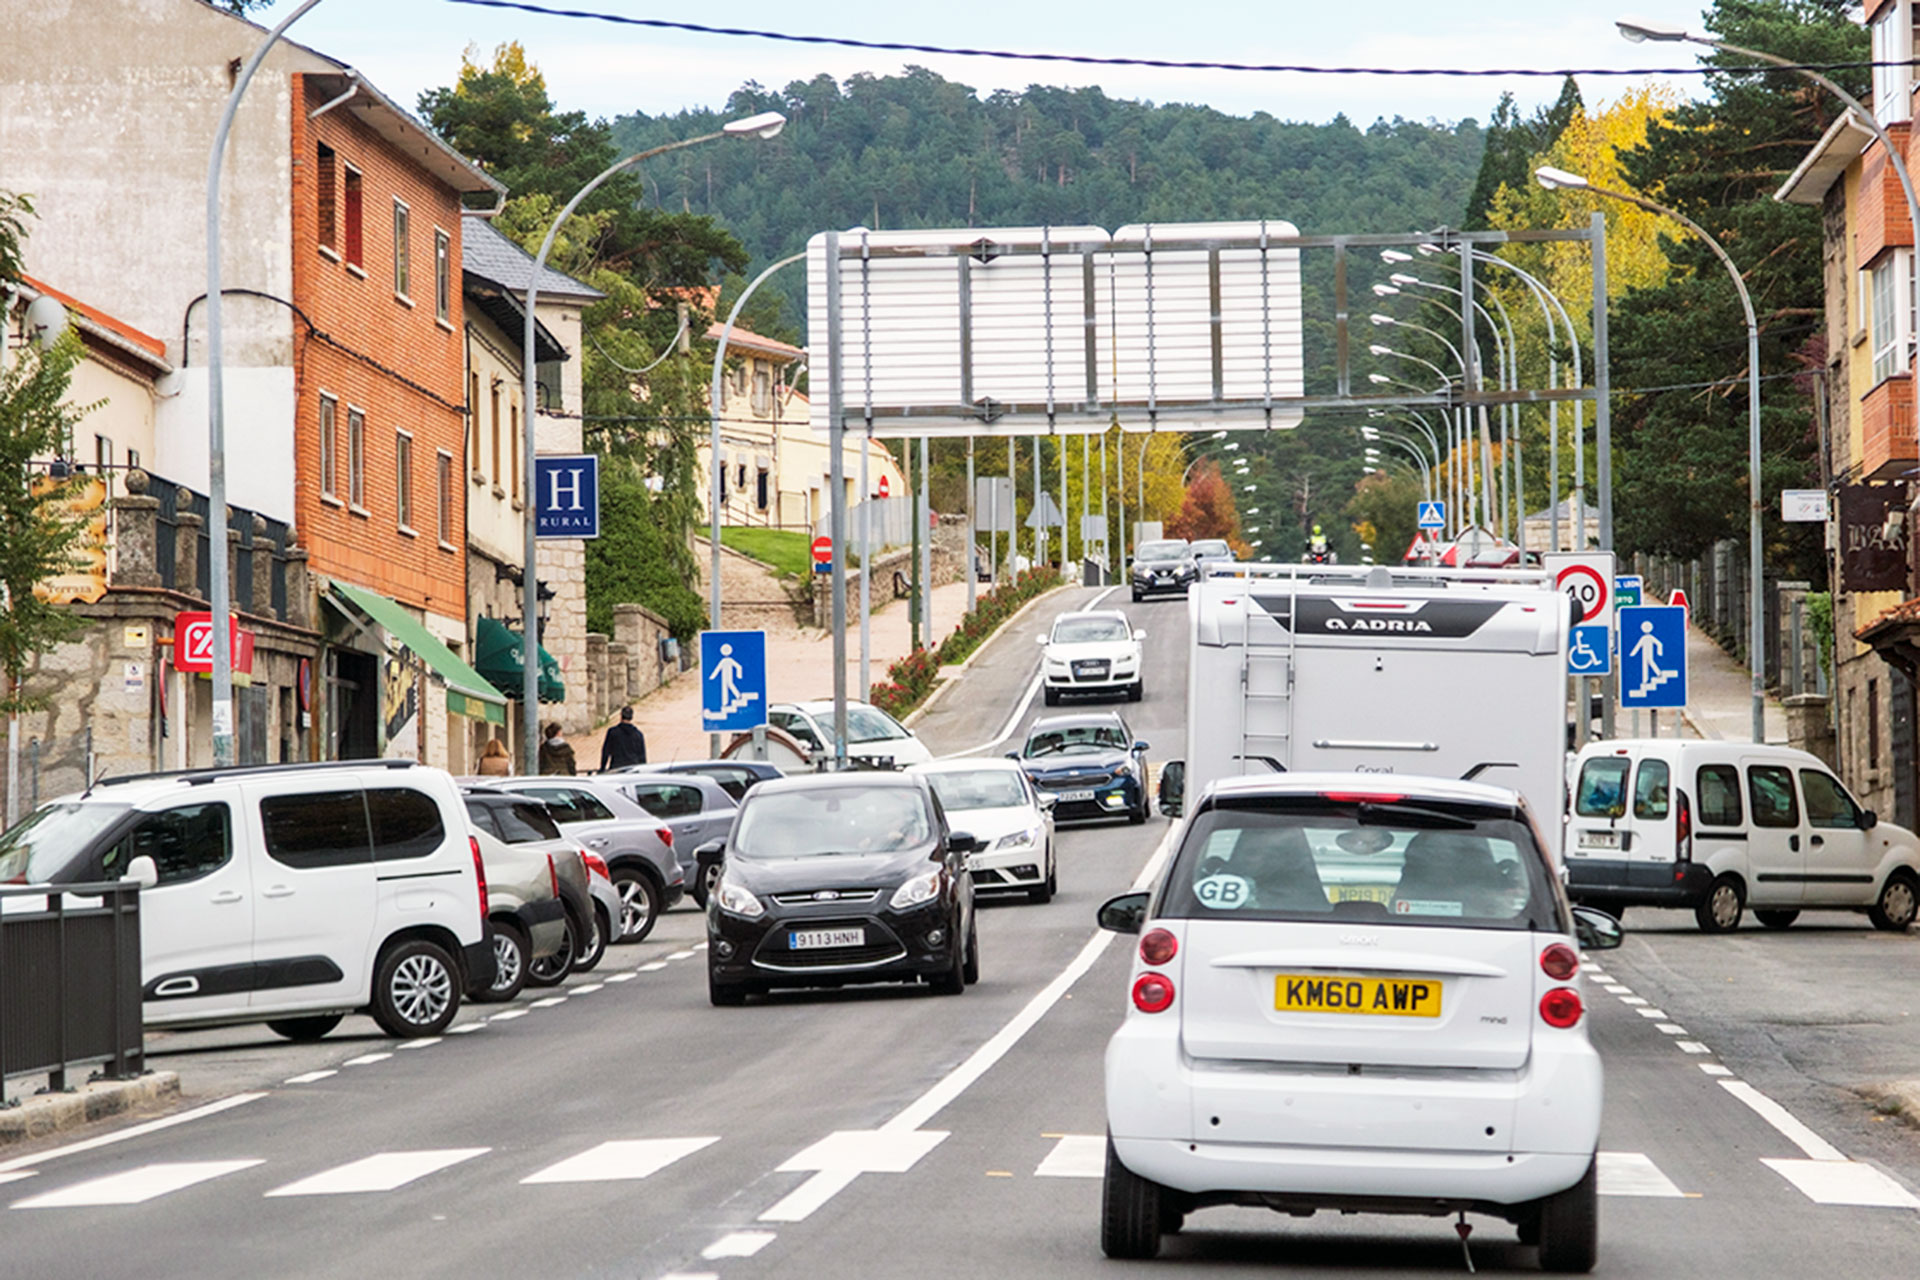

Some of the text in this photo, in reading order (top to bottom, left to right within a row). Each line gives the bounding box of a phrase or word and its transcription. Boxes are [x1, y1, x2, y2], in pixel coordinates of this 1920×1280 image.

[546, 469, 585, 511] H
[540, 517, 592, 528] RURAL
[1351, 618, 1433, 632] ADRIA
[1200, 880, 1241, 902] GB
[1286, 979, 1429, 1010] KM60 AWP
